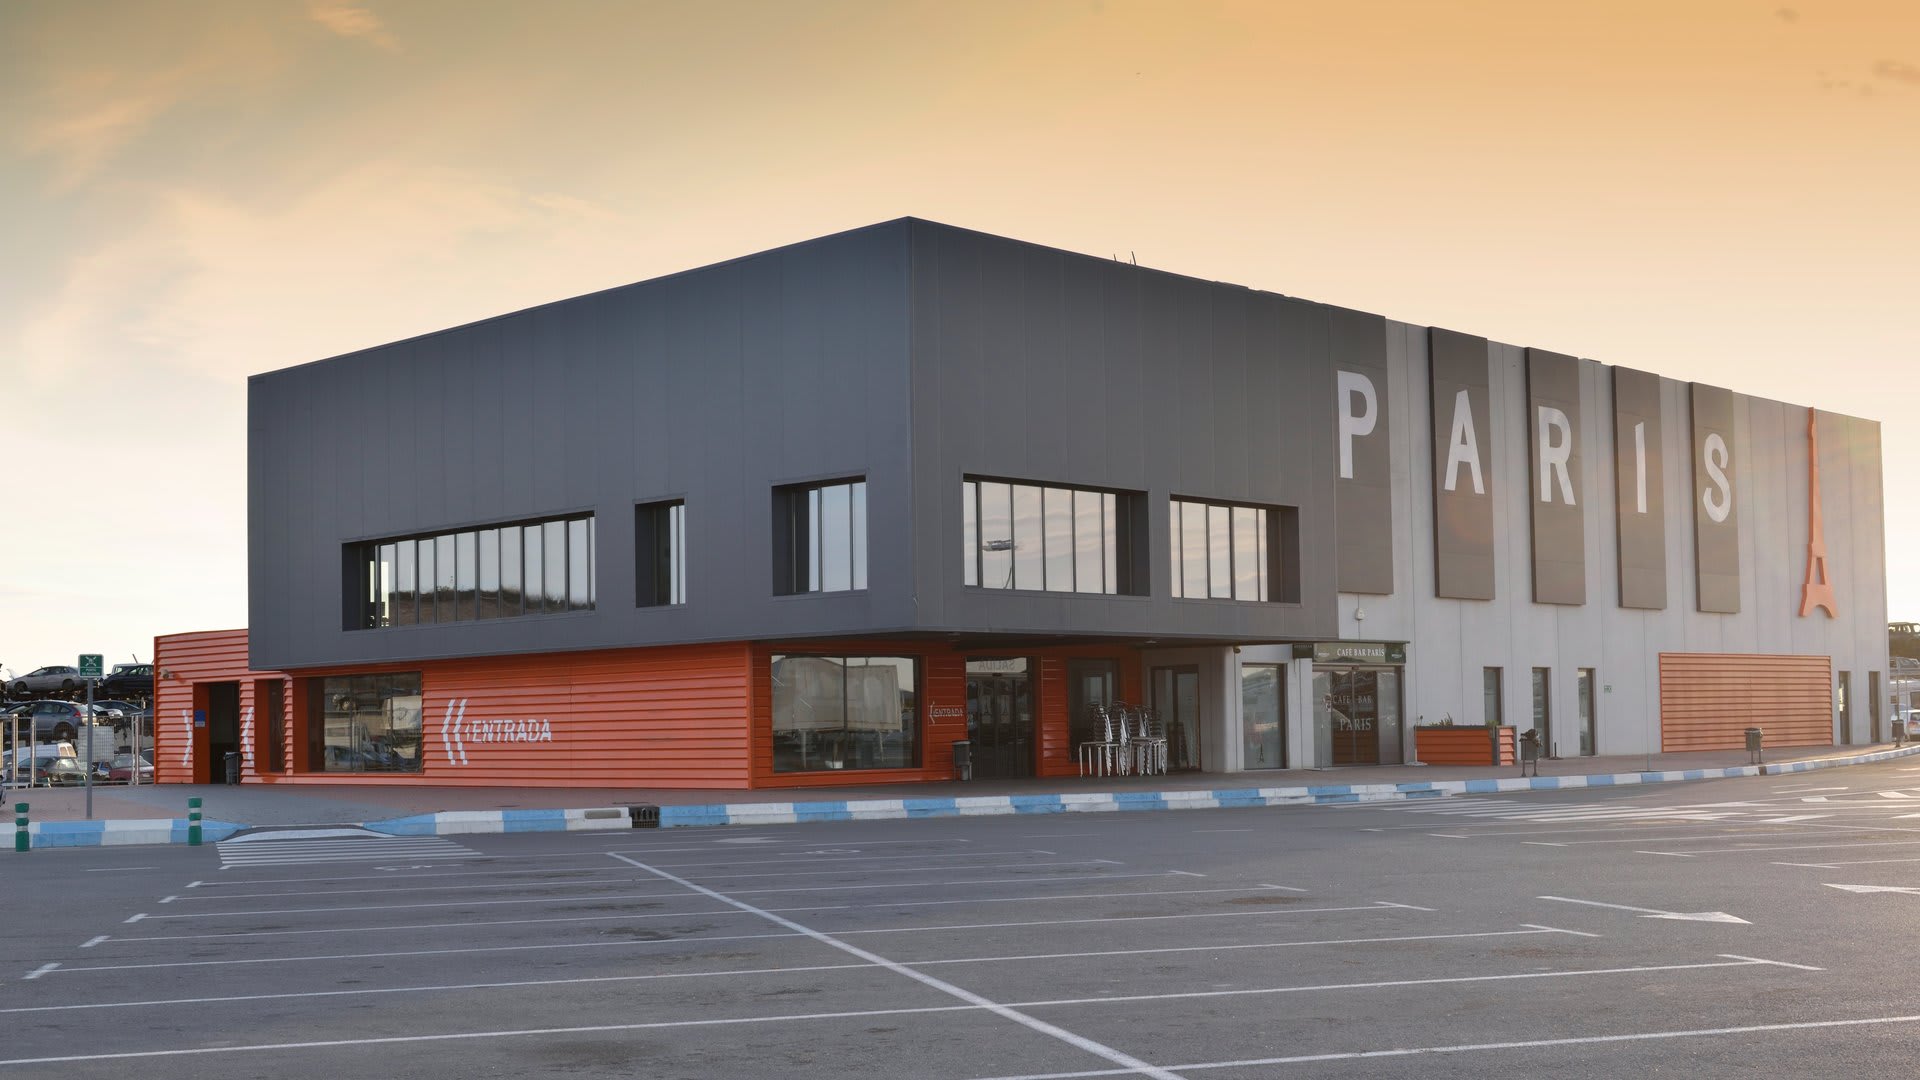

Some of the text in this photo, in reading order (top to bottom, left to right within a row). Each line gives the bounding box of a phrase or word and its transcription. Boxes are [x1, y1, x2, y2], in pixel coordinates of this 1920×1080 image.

[1338, 370, 1731, 522] PARIS
[1354, 648, 1367, 657] BAR
[934, 707, 964, 717] ENTRADA
[472, 718, 552, 743] ENTRADA
[1340, 718, 1372, 731] PARIS
